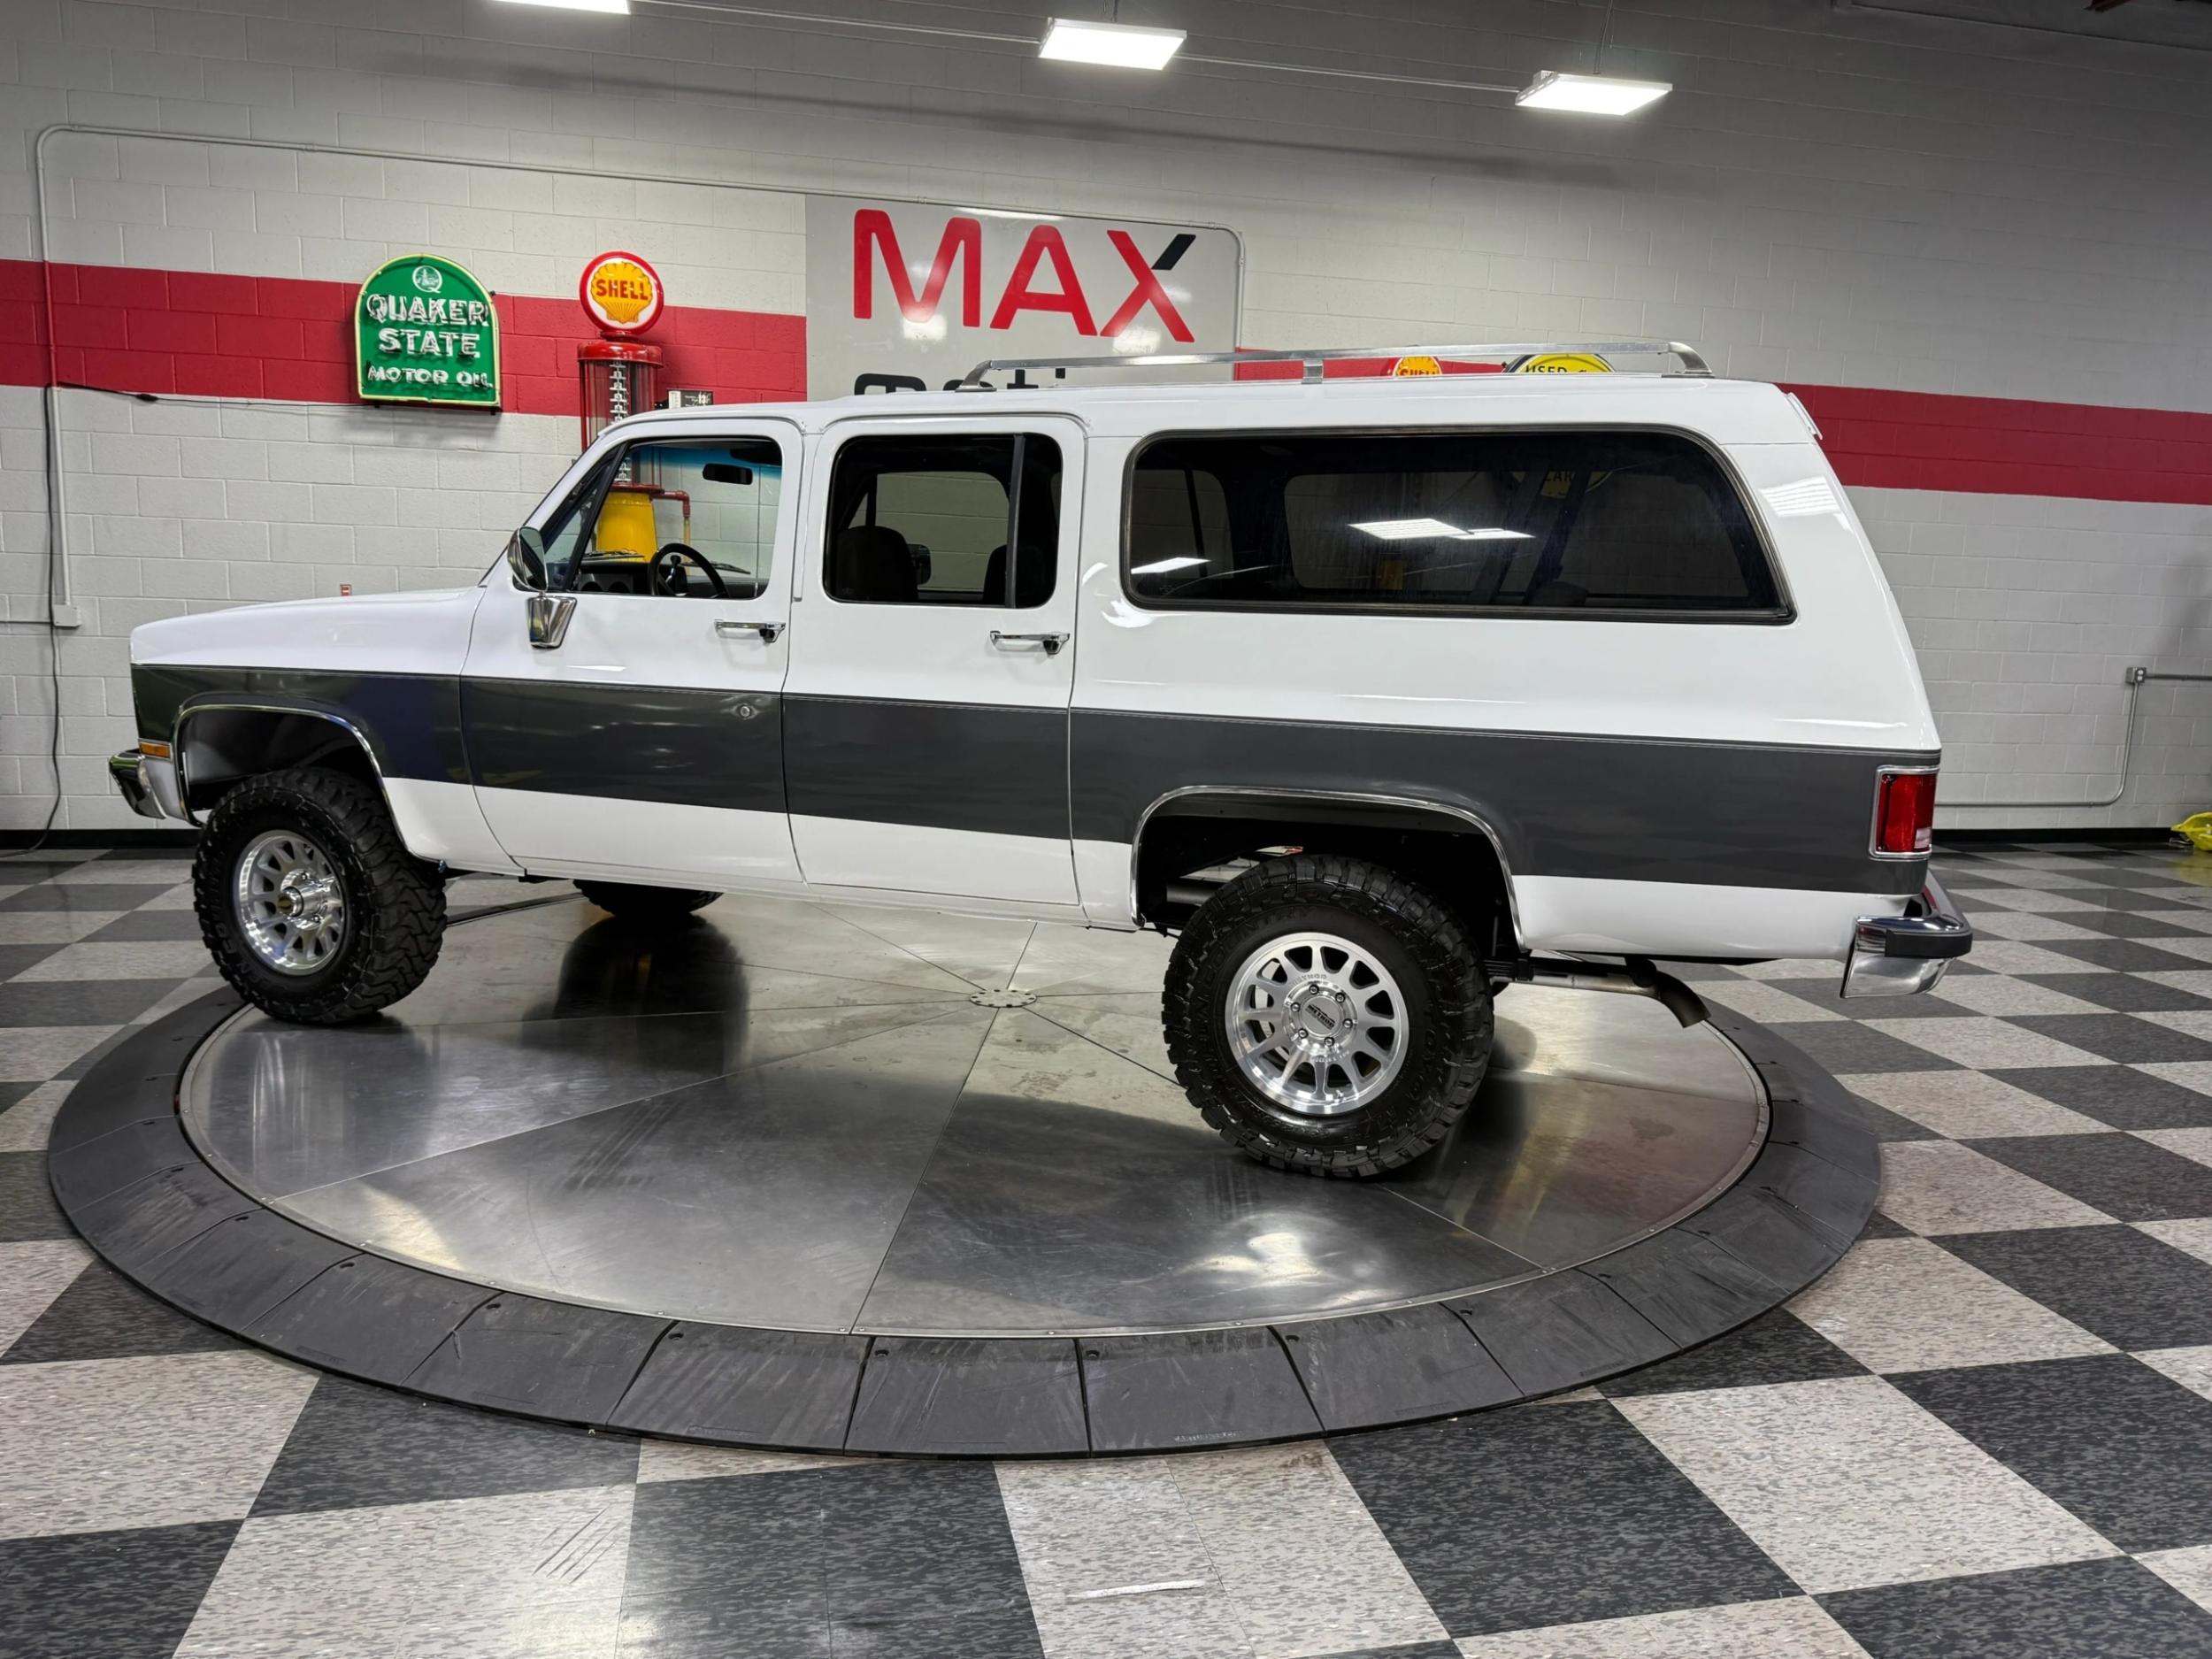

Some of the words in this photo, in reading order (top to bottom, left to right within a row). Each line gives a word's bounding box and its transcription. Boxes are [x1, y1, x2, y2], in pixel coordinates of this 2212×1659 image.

[595, 279, 648, 300] SHELL
[853, 209, 1196, 342] MAX
[366, 293, 488, 326] QUAKER
[379, 327, 480, 358] STATE
[368, 365, 449, 384] MOTOR
[456, 371, 493, 388] OIL
